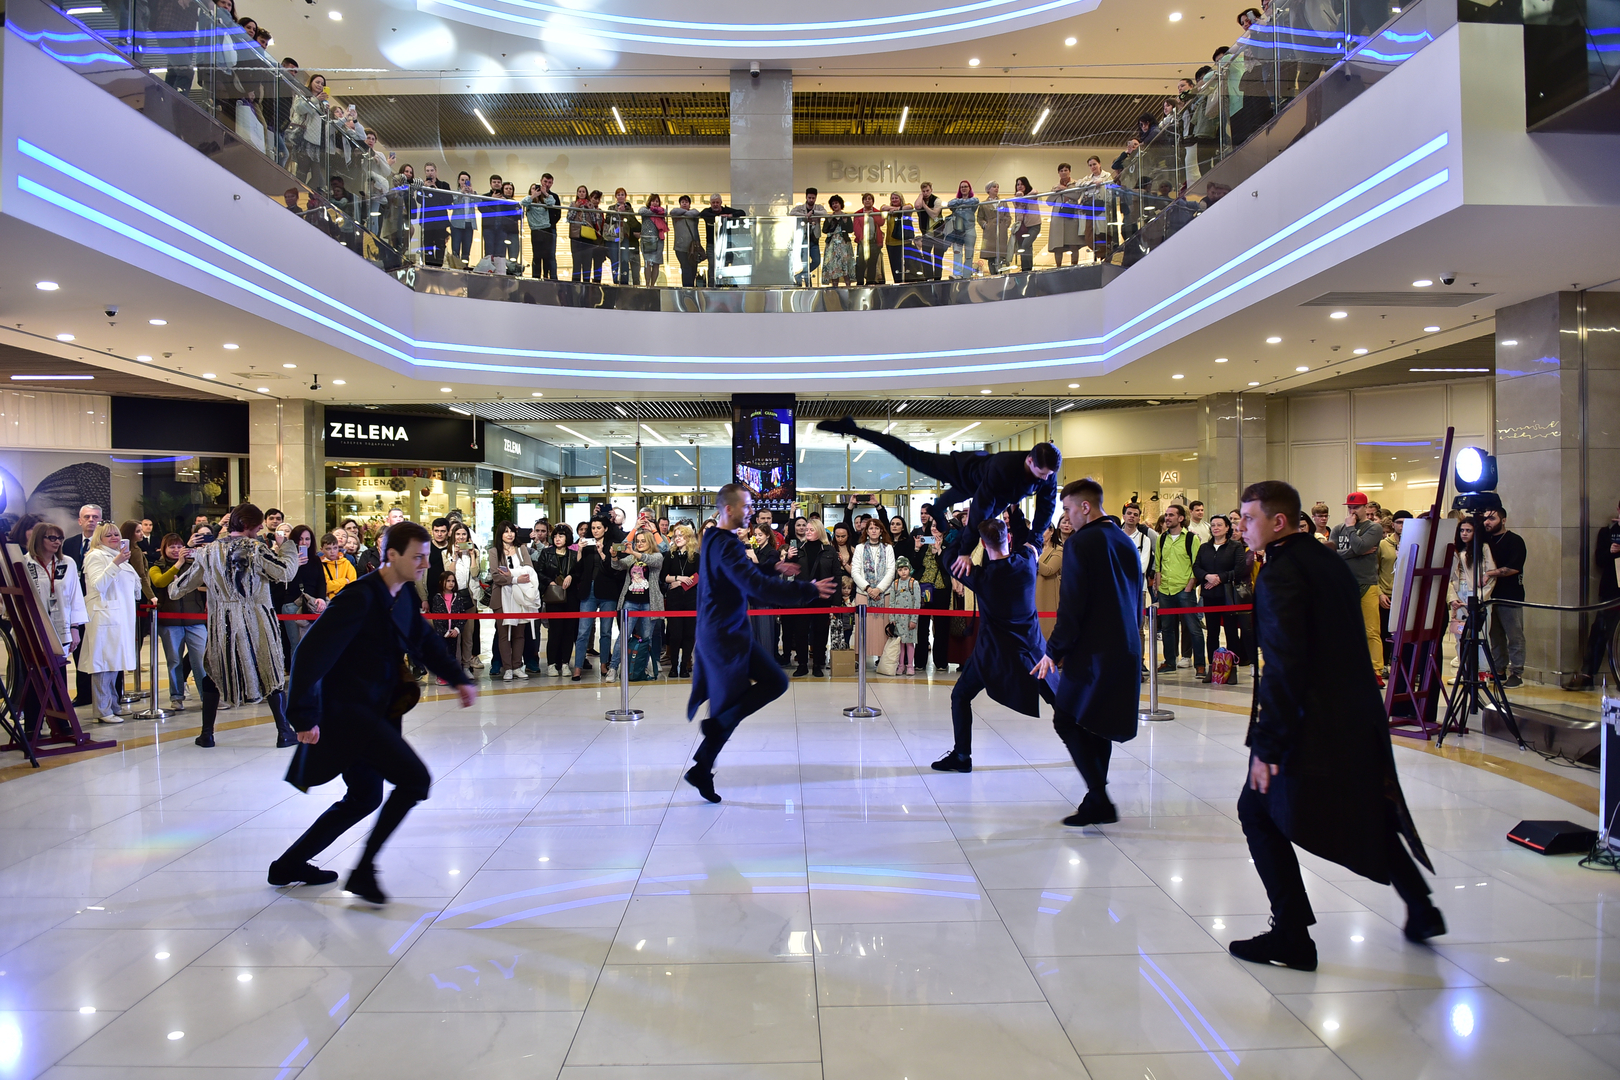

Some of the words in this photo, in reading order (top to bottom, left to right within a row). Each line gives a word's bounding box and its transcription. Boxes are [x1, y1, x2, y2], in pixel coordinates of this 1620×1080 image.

[828, 159, 921, 183] Bershka
[329, 422, 409, 441] ZELENA
[503, 438, 522, 455] ZELENA
